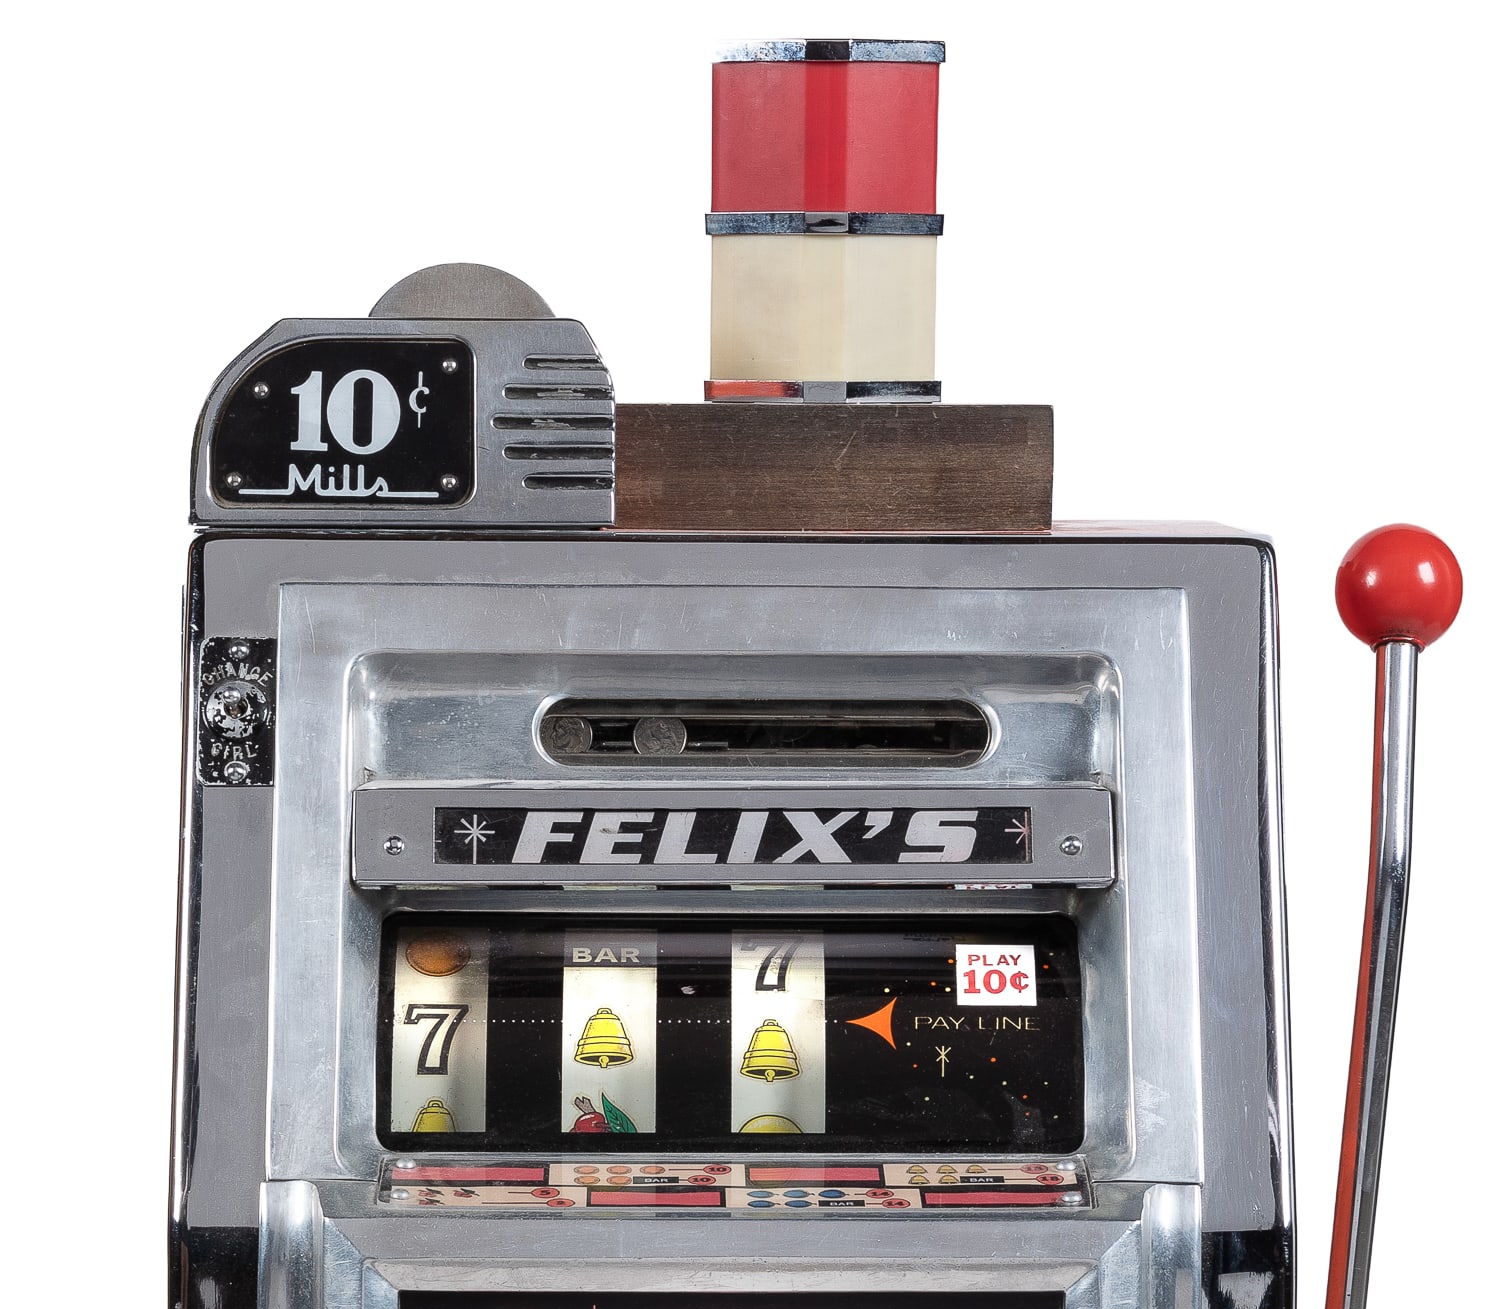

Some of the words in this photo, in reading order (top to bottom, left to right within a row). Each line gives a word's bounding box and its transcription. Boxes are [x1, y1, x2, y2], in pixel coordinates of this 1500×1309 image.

[511, 809, 979, 864] FELIX'S
[572, 946, 641, 963] BAR
[740, 938, 804, 992] 7
[967, 954, 1022, 966] PLAY
[963, 969, 1029, 994] 10¢
[914, 1016, 965, 1030] PAY
[978, 1016, 1041, 1031] LINE
[403, 1003, 470, 1075] 7
